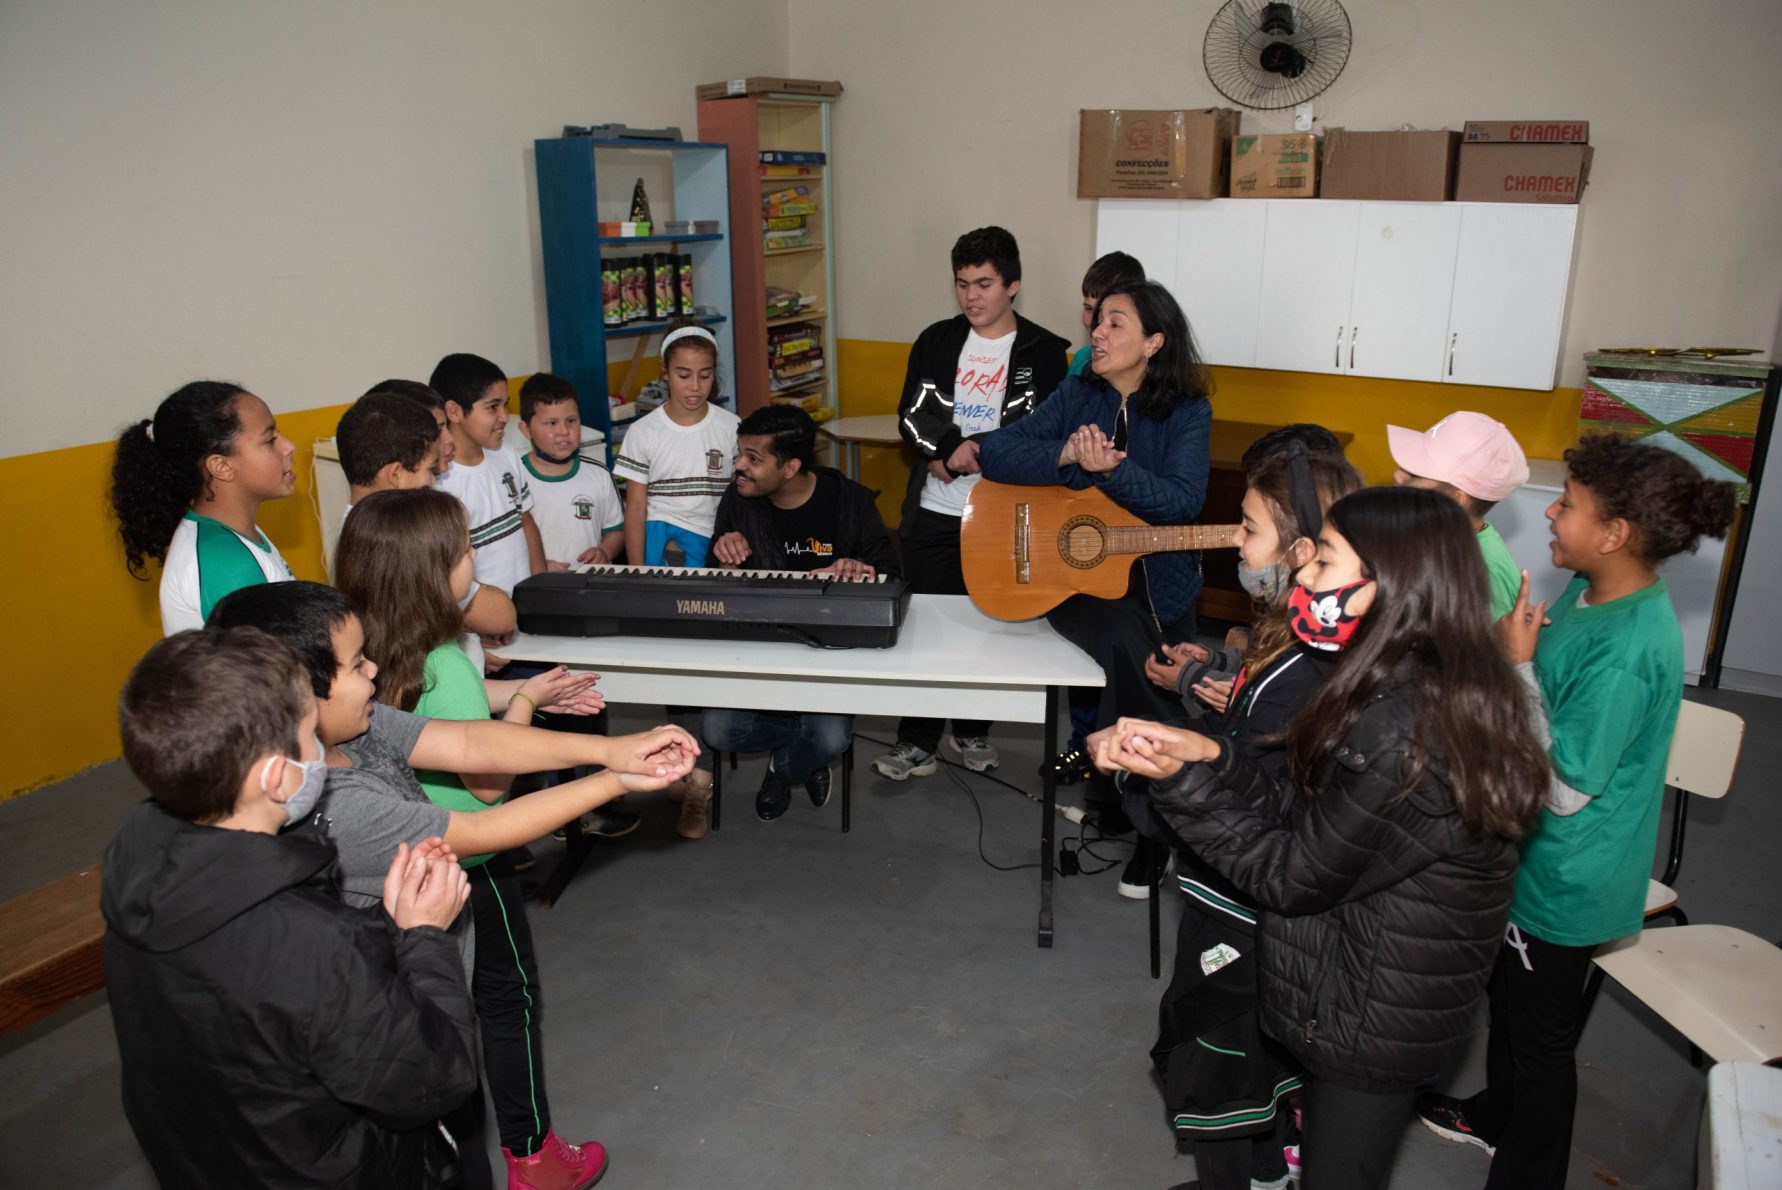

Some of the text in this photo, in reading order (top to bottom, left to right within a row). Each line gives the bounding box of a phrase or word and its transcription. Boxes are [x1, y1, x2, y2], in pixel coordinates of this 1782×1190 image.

[1115, 159, 1169, 169] CONFECÇÕES
[1503, 175, 1576, 193] CHAMEX
[953, 402, 996, 421] ENVER
[676, 600, 725, 615] YAMAHA
